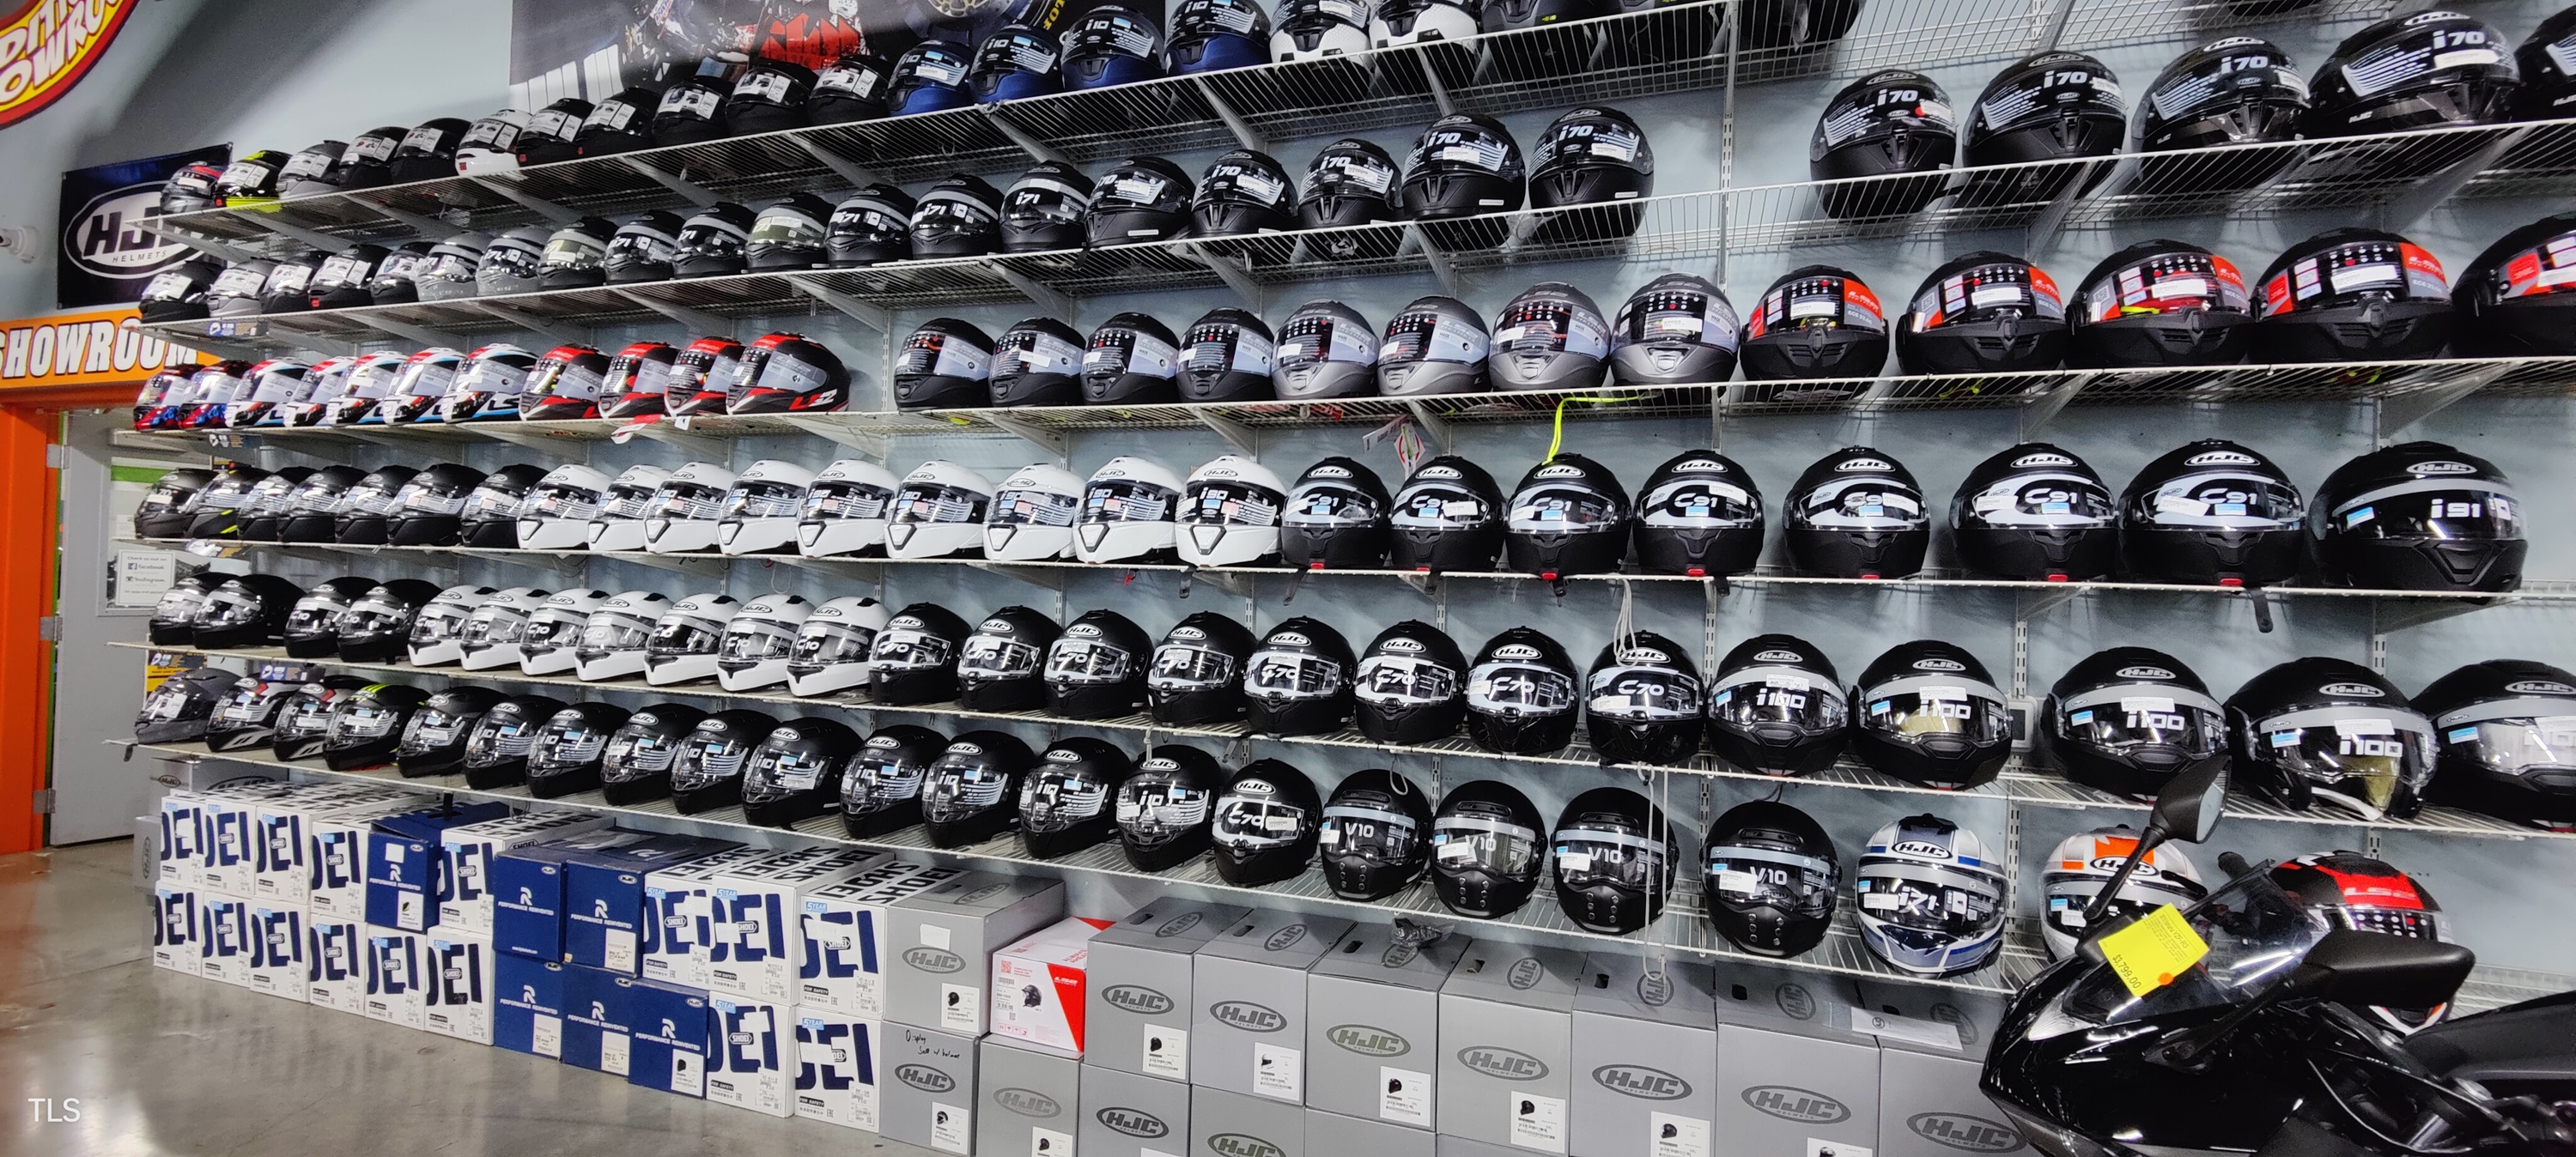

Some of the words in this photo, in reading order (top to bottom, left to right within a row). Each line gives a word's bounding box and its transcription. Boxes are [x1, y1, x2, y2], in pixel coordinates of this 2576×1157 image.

[1185, 1, 1208, 14] i10
[1085, 19, 1109, 31] i10
[2433, 30, 2486, 48] i70
[2221, 56, 2269, 74] i70
[2044, 71, 2087, 88] i70
[1877, 89, 1918, 106] i70
[2348, 111, 2373, 123] HJC
[1427, 131, 1461, 147] i70
[1558, 125, 1594, 141] i70
[1321, 156, 1351, 169] i70
[1212, 165, 1241, 178] i70
[1016, 192, 1041, 205] i71
[923, 203, 947, 216] i71
[112, 250, 167, 264] HELMETS
[788, 389, 837, 409] LS2
[1678, 462, 1724, 471] HJC
[1843, 460, 1891, 469] HJC
[2018, 456, 2072, 465] HJC
[2191, 454, 2255, 464] HJC
[1542, 468, 1581, 476] HJC
[2415, 463, 2470, 473] HJC
[1202, 487, 1227, 499] i90
[1305, 494, 1340, 507] C91
[1674, 493, 1717, 508] C91
[2025, 488, 2077, 504] C91
[2199, 488, 2257, 504] C91
[1412, 495, 1447, 510] C91
[1533, 497, 1571, 512] C91
[2431, 499, 2481, 518] i91
[892, 618, 921, 627] HJC
[981, 621, 1012, 630] HJC
[1067, 626, 1098, 635] HJC
[1172, 628, 1203, 638] HJC
[1272, 633, 1307, 645] HJC
[1385, 640, 1421, 651] HJC
[1497, 646, 1538, 658] HJC
[1625, 649, 1668, 661] HJC
[1757, 651, 1799, 660] HJC
[2123, 668, 2172, 677] HJC
[1492, 675, 1534, 693] C70
[1619, 680, 1664, 696] C70
[2327, 685, 2379, 695] HJC
[2512, 683, 2570, 694] HJC
[1757, 689, 1805, 709] i100
[1920, 699, 1971, 719] i100
[856, 766, 875, 778] i10
[939, 771, 958, 784] i10
[1036, 780, 1057, 796] i10
[1237, 782, 1273, 792] HJC
[1139, 791, 1163, 806] i10
[1345, 821, 1374, 839] V10
[1465, 834, 1497, 852] V10
[1899, 843, 1948, 857] HJC
[1588, 846, 1621, 864] V10
[773, 849, 883, 881] SHOEI
[814, 863, 920, 898] SHOEI
[1750, 867, 1787, 885] V10
[858, 867, 962, 904] SHOEI
[2343, 887, 2417, 899] LS2
[1899, 887, 1936, 910] i71
[498, 901, 528, 911] PERFORMANCE
[529, 906, 554, 916] REINVENTED
[571, 913, 603, 924] PERFORMANCE
[605, 919, 632, 929] REINVENTED
[2172, 929, 2189, 948] YZF-R3
[912, 950, 958, 971] HJC
[1515, 959, 1538, 988] HJC
[2112, 954, 2142, 989] $3,799.00
[1054, 976, 1078, 985] LS2
[500, 998, 531, 1009] PERFORMANCE
[532, 1003, 557, 1015] REINVENTED
[1110, 989, 1166, 1010] HJC
[568, 1015, 599, 1027] PERFORMANCE
[601, 1021, 629, 1032] REINVENTED
[1219, 1004, 1278, 1027] HJC
[635, 1033, 670, 1045] PERFORMANCE
[671, 1039, 701, 1051] REINVENTED
[732, 1034, 749, 1043] SHOEI
[906, 1029, 927, 1045] Display
[1337, 1029, 1401, 1053] HJC
[918, 1045, 930, 1055] Sell
[1469, 1051, 1538, 1077] HJC
[902, 1068, 948, 1089] HJC
[1604, 1070, 1680, 1096] HJC
[1002, 1093, 1055, 1115] HJC
[1754, 1091, 1839, 1118] HJC
[1106, 1111, 1160, 1135] HJC
[1921, 1118, 2016, 1147] HJC
[1217, 1137, 1276, 1157] HJC
